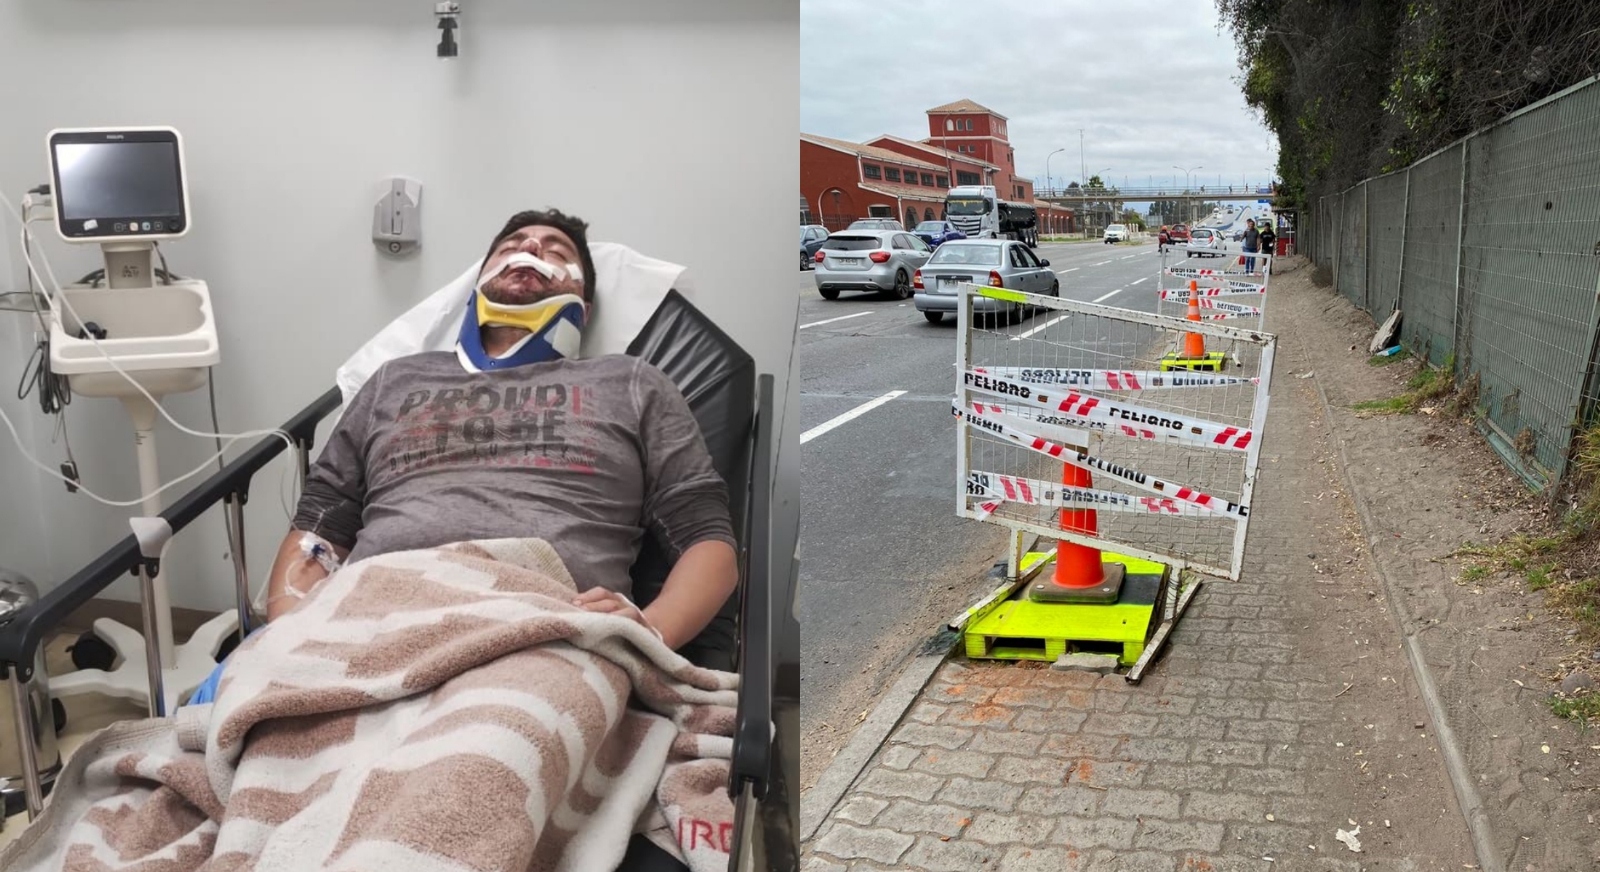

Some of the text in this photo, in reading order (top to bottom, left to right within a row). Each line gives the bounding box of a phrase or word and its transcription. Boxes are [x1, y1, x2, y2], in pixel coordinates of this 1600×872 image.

[398, 383, 567, 416] PROUD
[965, 372, 1031, 400] PELIGRO
[434, 409, 567, 447] TO BE
[1109, 406, 1184, 431] PELIGRO
[1076, 453, 1147, 485] PELIGRO
